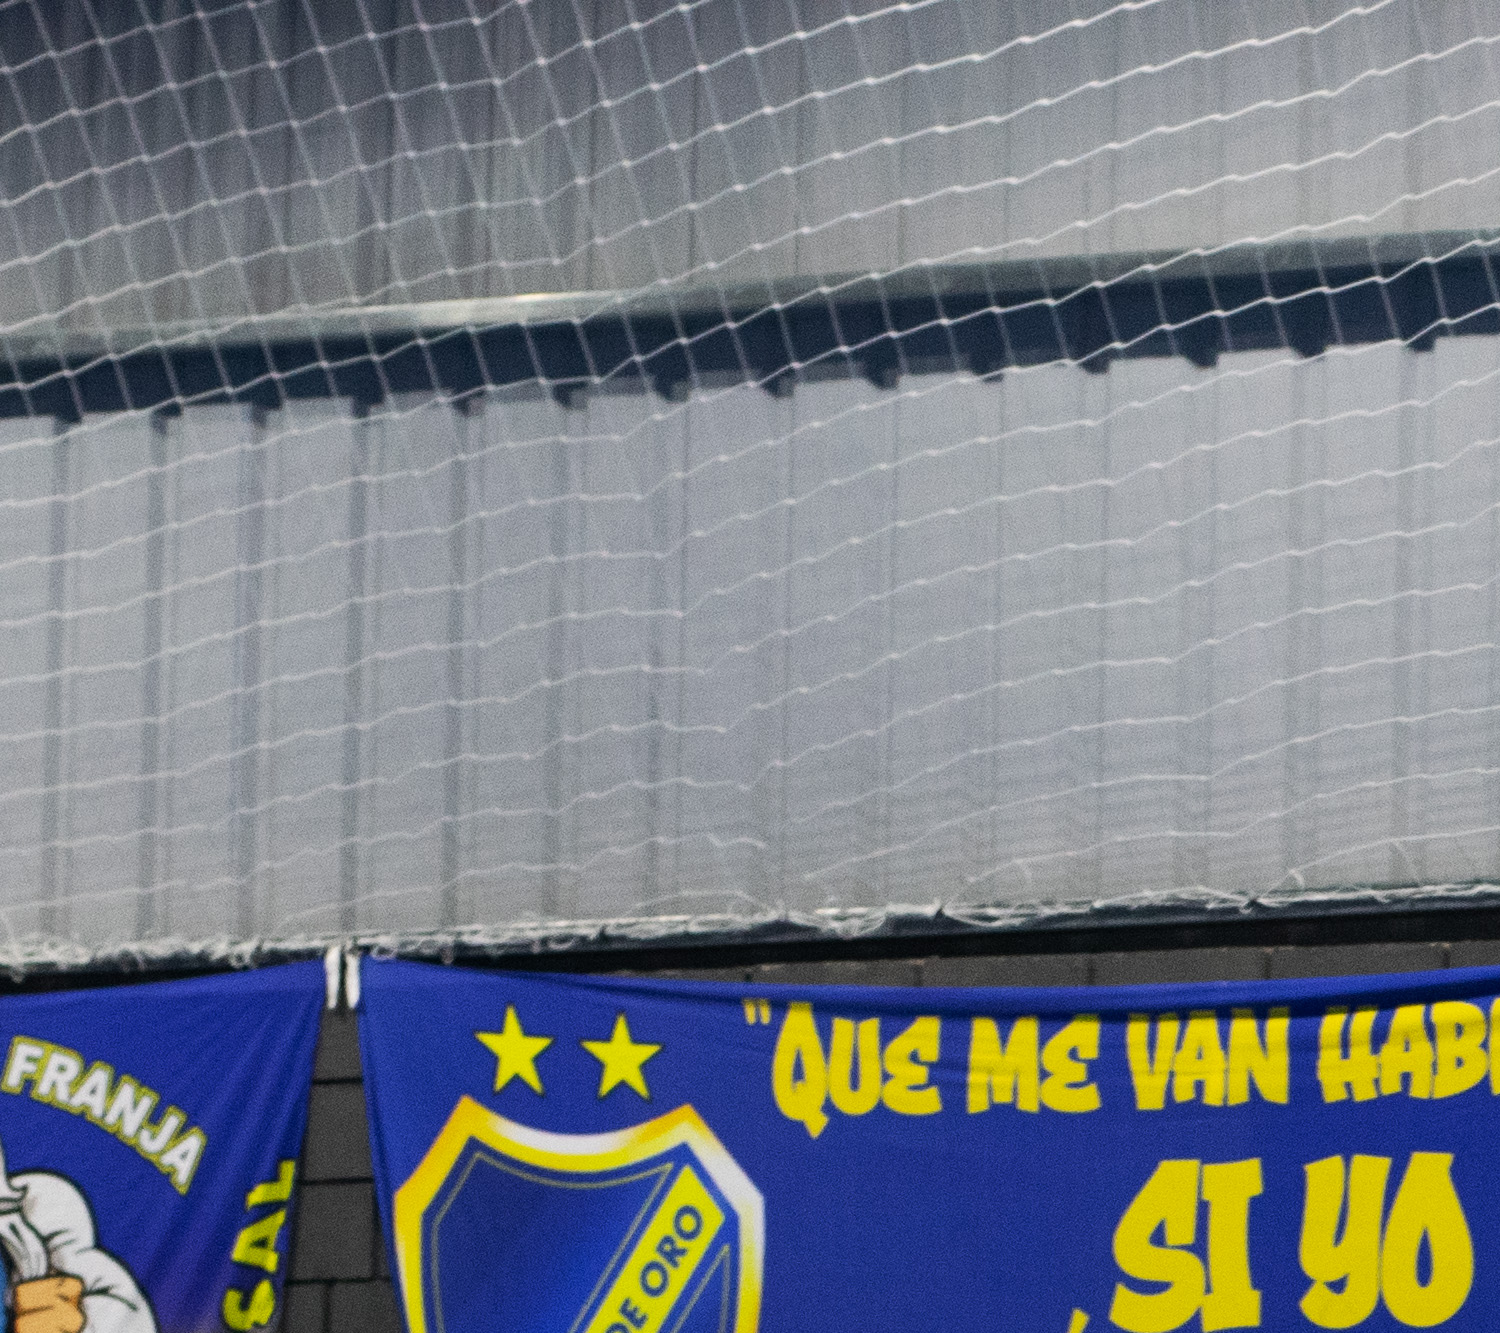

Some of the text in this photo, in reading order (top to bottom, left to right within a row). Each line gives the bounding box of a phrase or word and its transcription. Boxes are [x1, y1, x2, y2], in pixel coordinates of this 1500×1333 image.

[3, 1035, 207, 1195] FRANJA
[967, 1013, 1101, 1115] ME
[1126, 1007, 1290, 1111] VAN
[639, 1204, 703, 1297] ORO
[1109, 1157, 1262, 1333] SI
[1299, 1151, 1474, 1330] YO
